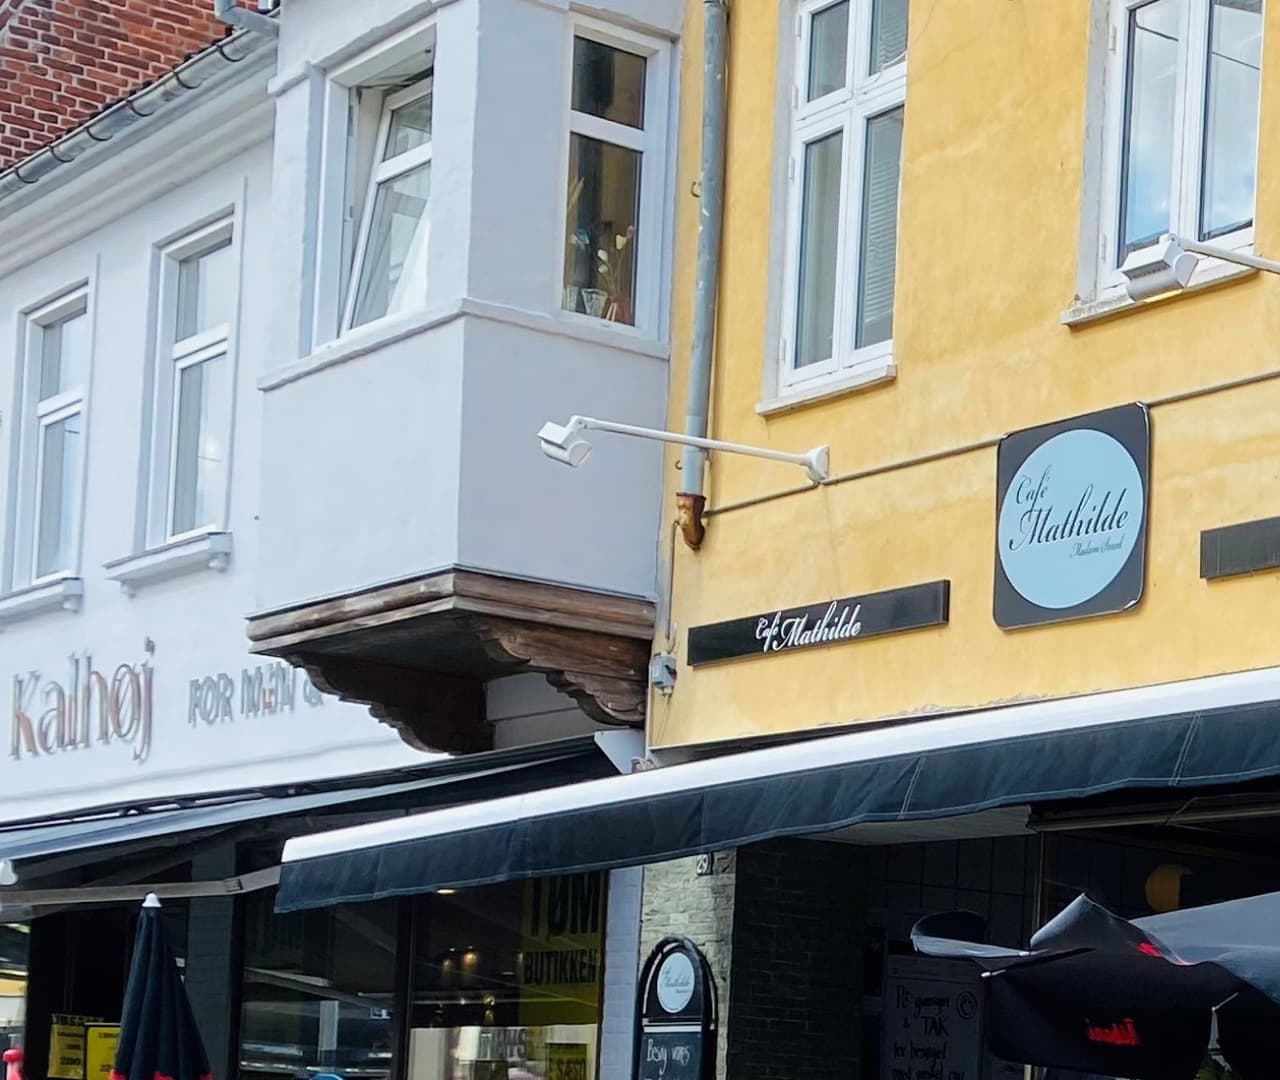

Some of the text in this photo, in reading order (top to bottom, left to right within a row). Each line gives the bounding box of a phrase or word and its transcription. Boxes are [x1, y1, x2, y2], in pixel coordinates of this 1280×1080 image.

[1016, 464, 1051, 512] Café
[1010, 483, 1128, 551] Mathilde
[755, 601, 862, 653] Café Mathilde
[9, 636, 156, 764] Kalhøj
[524, 949, 598, 984] BUTIKKEN
[920, 1015, 949, 1036] TAK
